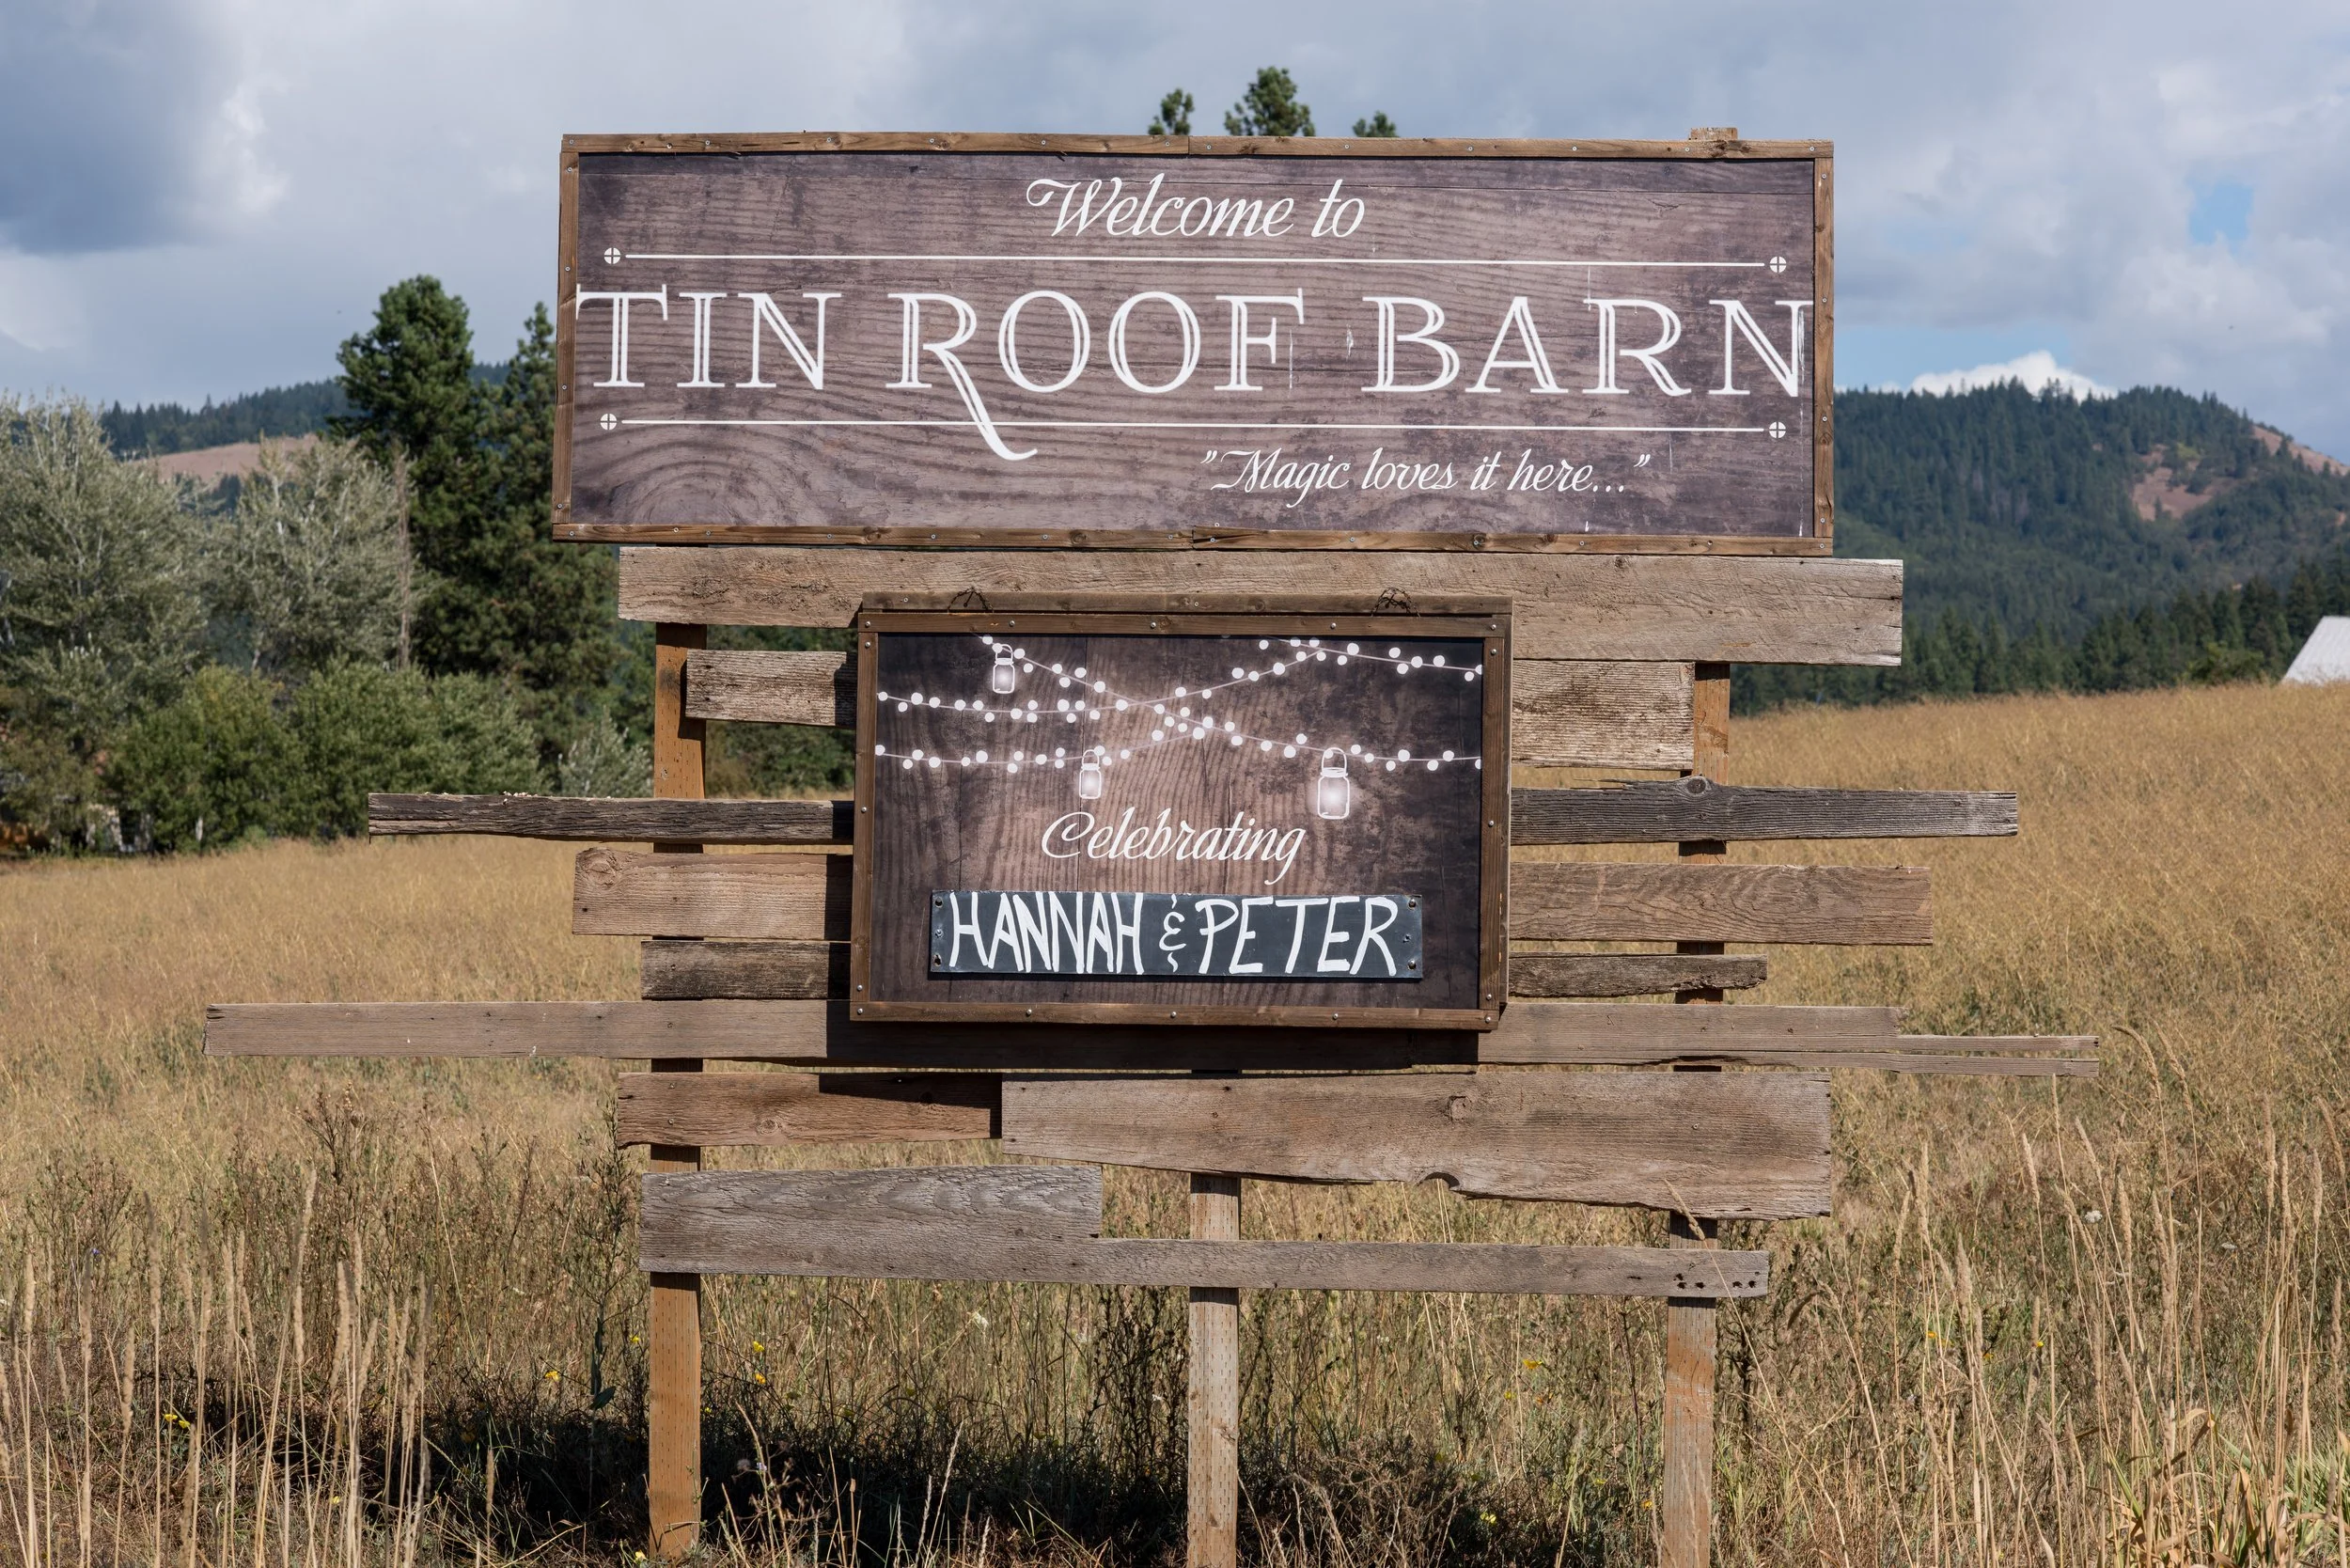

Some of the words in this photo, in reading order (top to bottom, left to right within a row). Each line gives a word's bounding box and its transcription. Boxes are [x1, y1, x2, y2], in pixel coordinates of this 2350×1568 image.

[1026, 173, 1293, 239] Welcome
[1309, 179, 1365, 239] to
[576, 283, 842, 391] TIN
[885, 287, 1306, 461] ROOF
[1361, 295, 1814, 398] BARN
[1362, 447, 1458, 494] loves
[1473, 450, 1500, 494] it
[1041, 807, 1307, 886] Celebrating
[948, 892, 1145, 975] HANNAH
[1158, 893, 1186, 972] &
[1195, 896, 1398, 975] PETER
